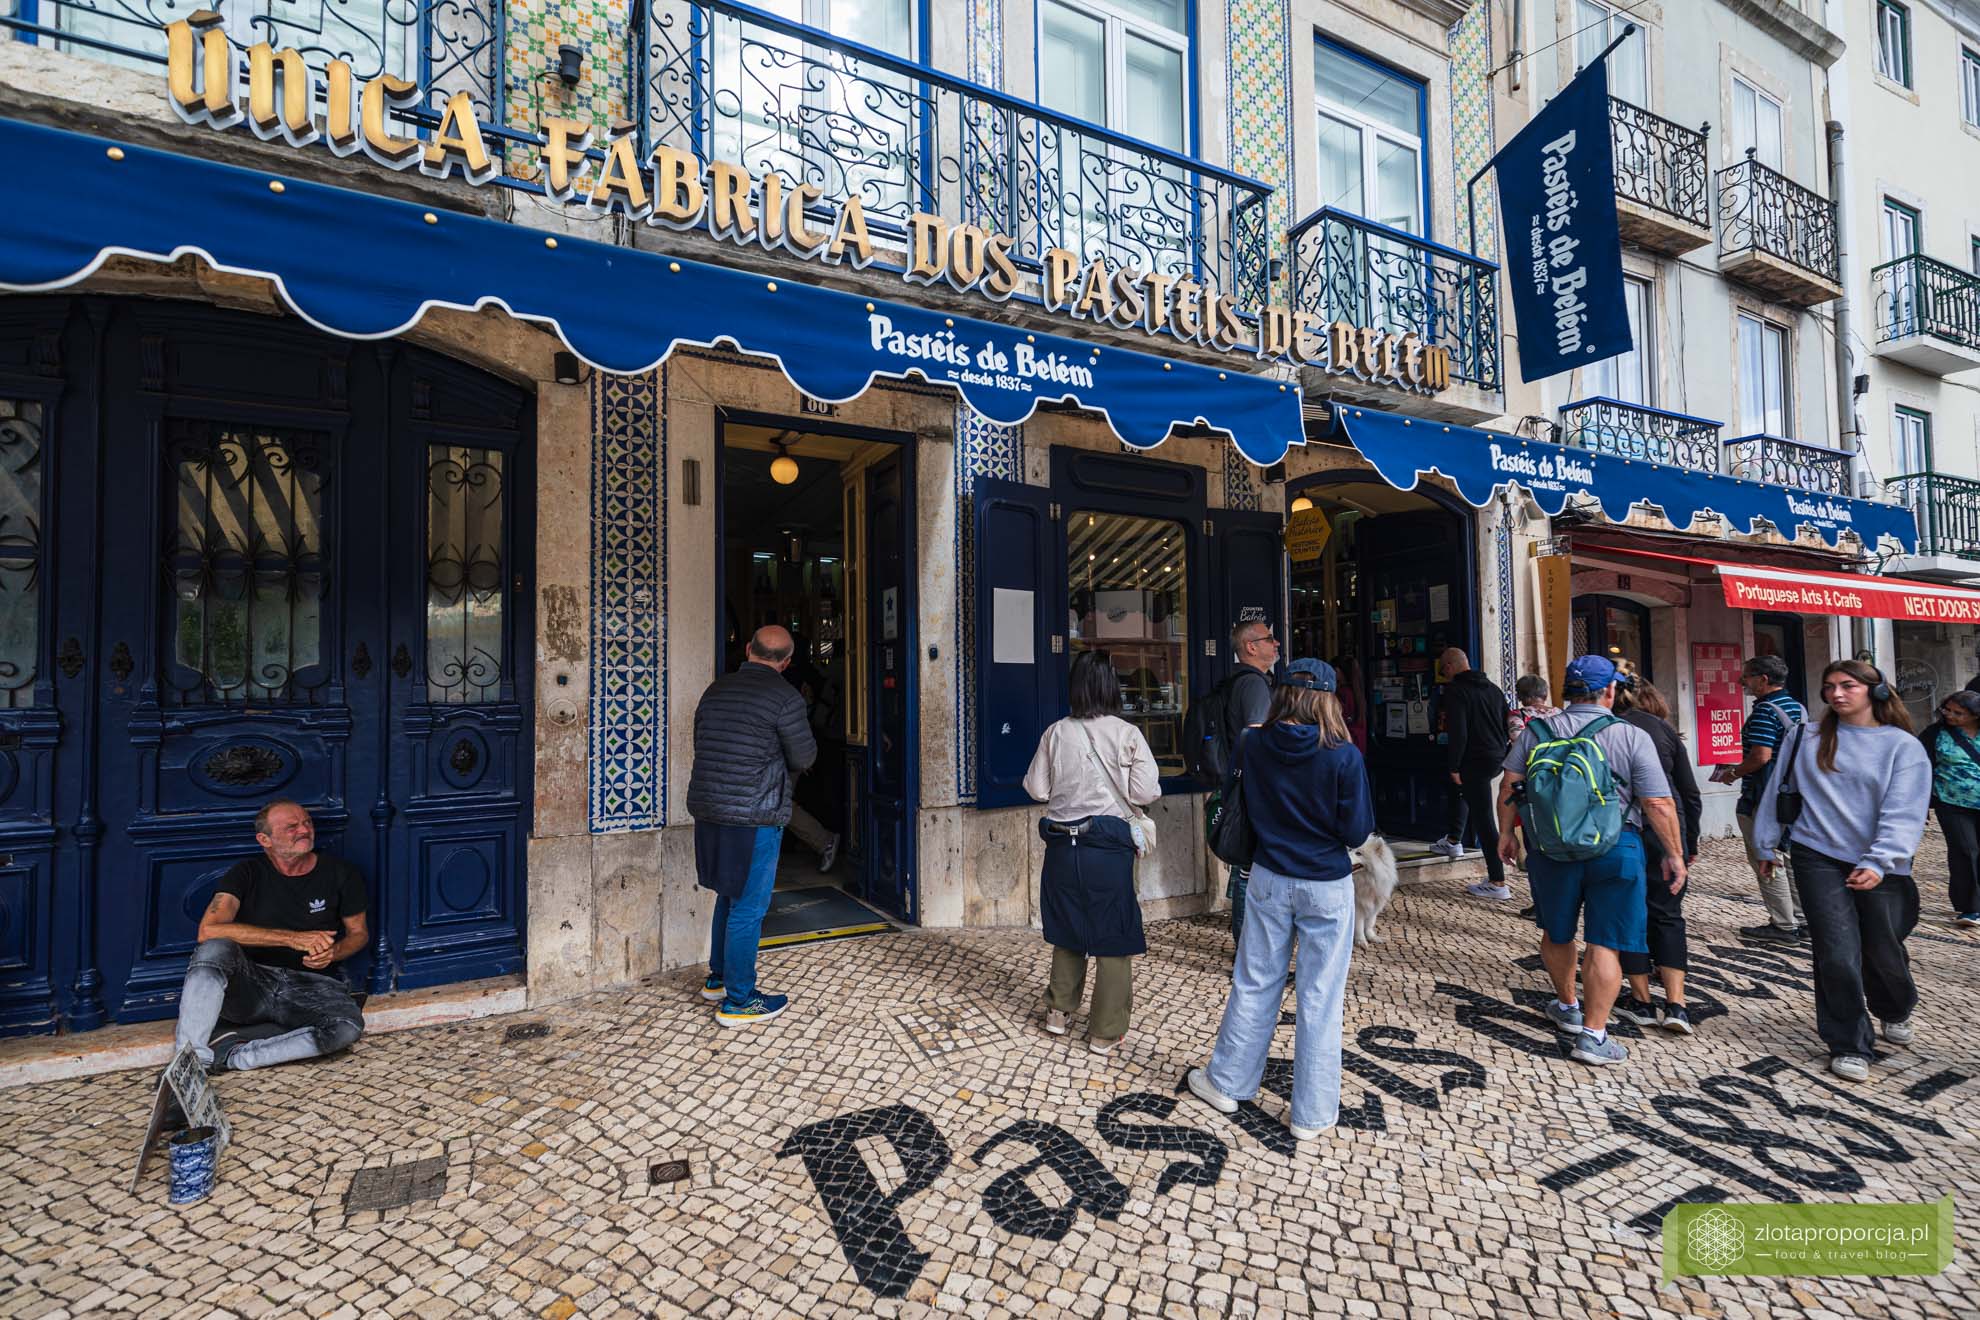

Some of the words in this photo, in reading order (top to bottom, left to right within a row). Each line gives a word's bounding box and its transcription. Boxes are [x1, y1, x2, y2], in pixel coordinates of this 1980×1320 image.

[539, 118, 873, 268] FÁBRICA
[904, 212, 1021, 300] DOS
[1257, 304, 1324, 367] DE
[1530, 227, 1546, 258] desde
[1547, 234, 1580, 268] de
[1533, 259, 1549, 283] 1837
[1552, 266, 1588, 355] Belém
[976, 341, 1009, 373] de
[1014, 343, 1094, 388] Belém
[961, 369, 994, 385] desde
[996, 375, 1021, 390] 1837
[1538, 456, 1554, 478] de
[1555, 455, 1593, 485] Belém
[1817, 502, 1828, 519] de
[1735, 581, 1799, 606] Portuguese
[1801, 588, 1823, 605] Arts
[1823, 590, 1832, 607] &
[1832, 593, 1862, 609] Crafts
[1904, 596, 1935, 617] NEXT
[1938, 600, 1971, 619] DOOR
[1711, 709, 1731, 721] NEXT
[1712, 723, 1733, 734] DOOR
[1712, 735, 1734, 747] SHOP
